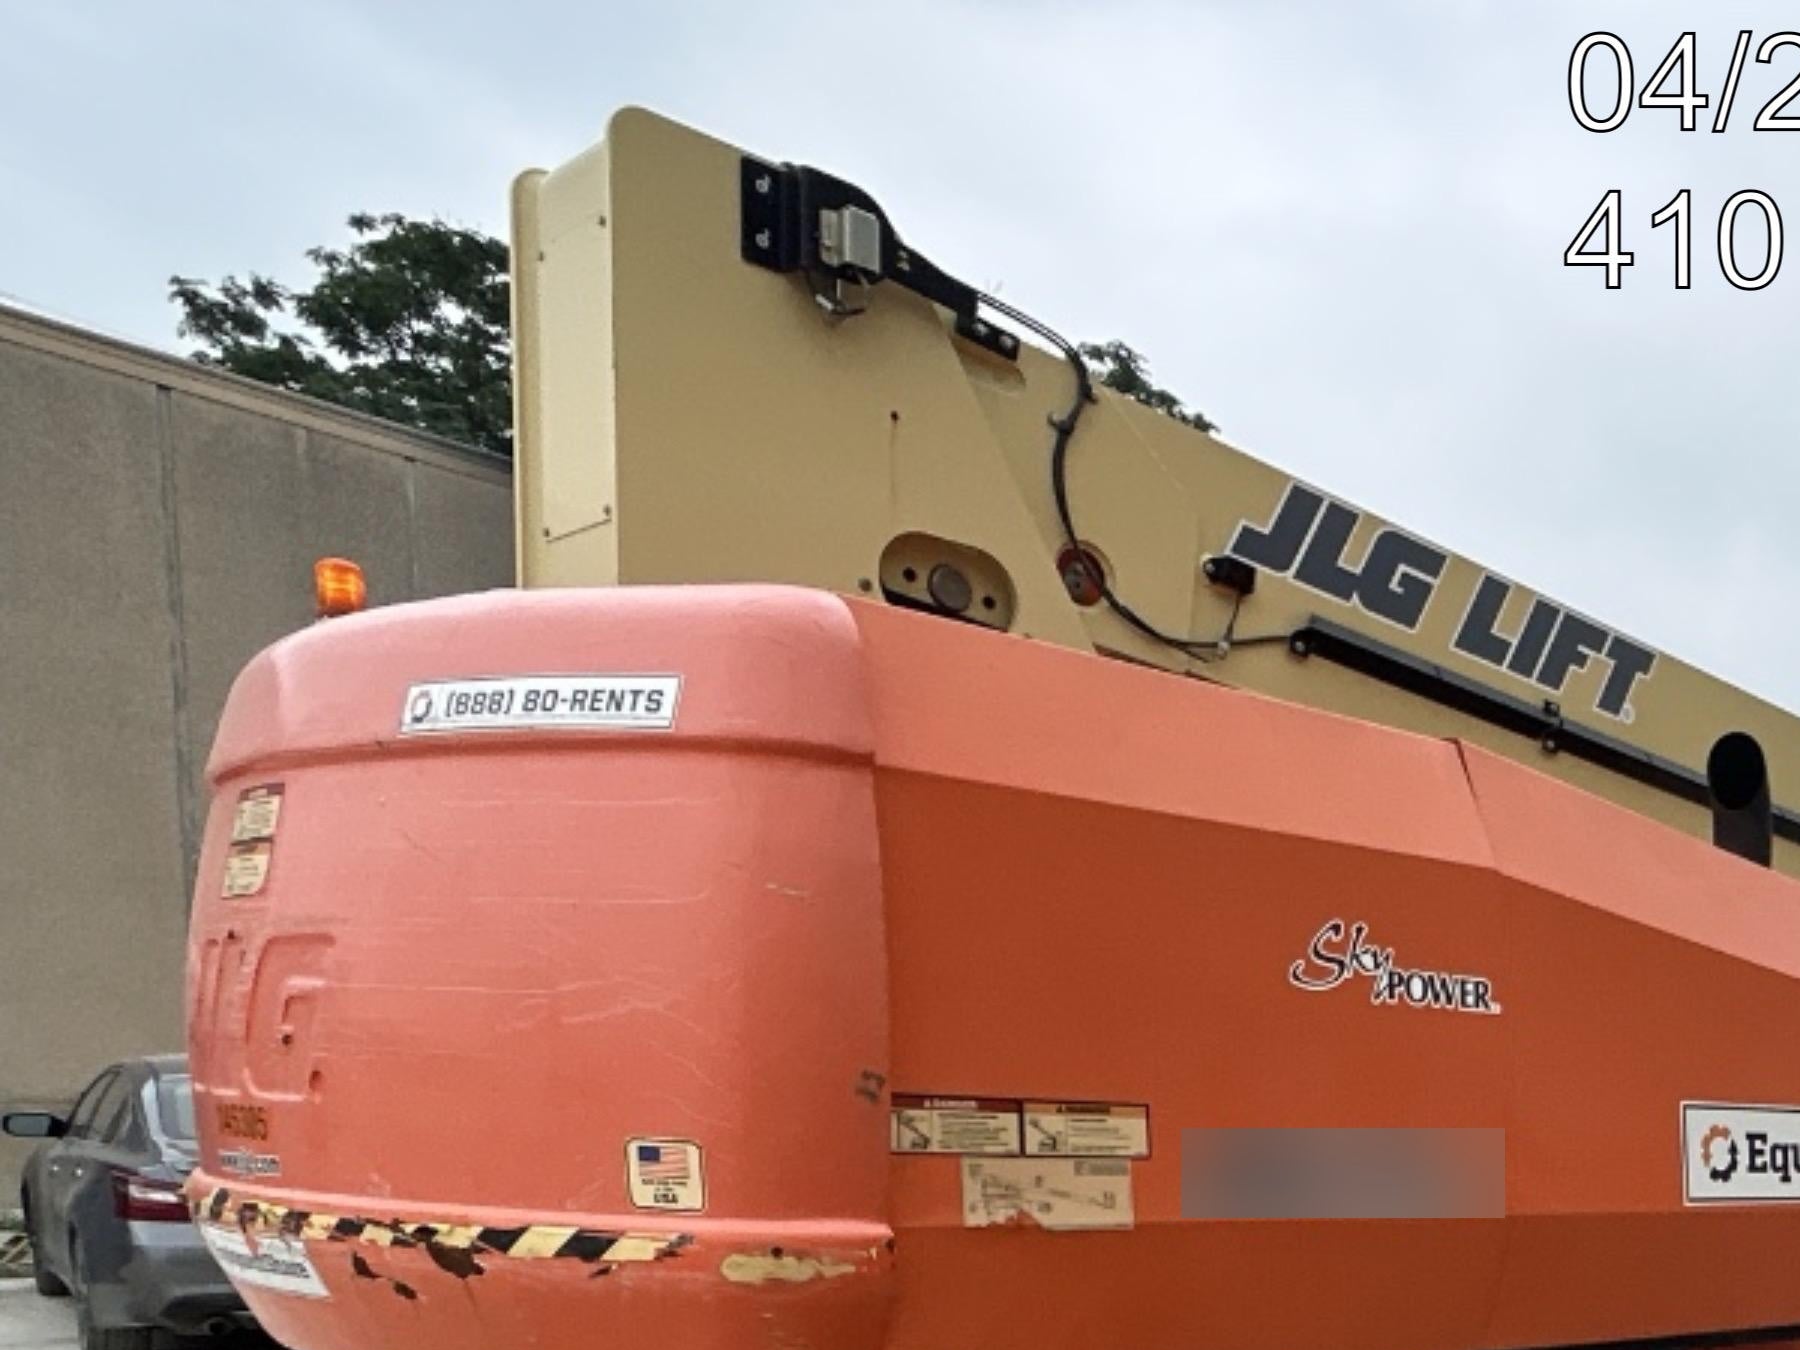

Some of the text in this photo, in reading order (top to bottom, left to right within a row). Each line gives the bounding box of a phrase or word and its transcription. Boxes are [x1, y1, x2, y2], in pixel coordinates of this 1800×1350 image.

[1227, 482, 1657, 719] JLG LIFT
[445, 688, 515, 718] (888)
[1291, 920, 1490, 1012] Sky POWER
